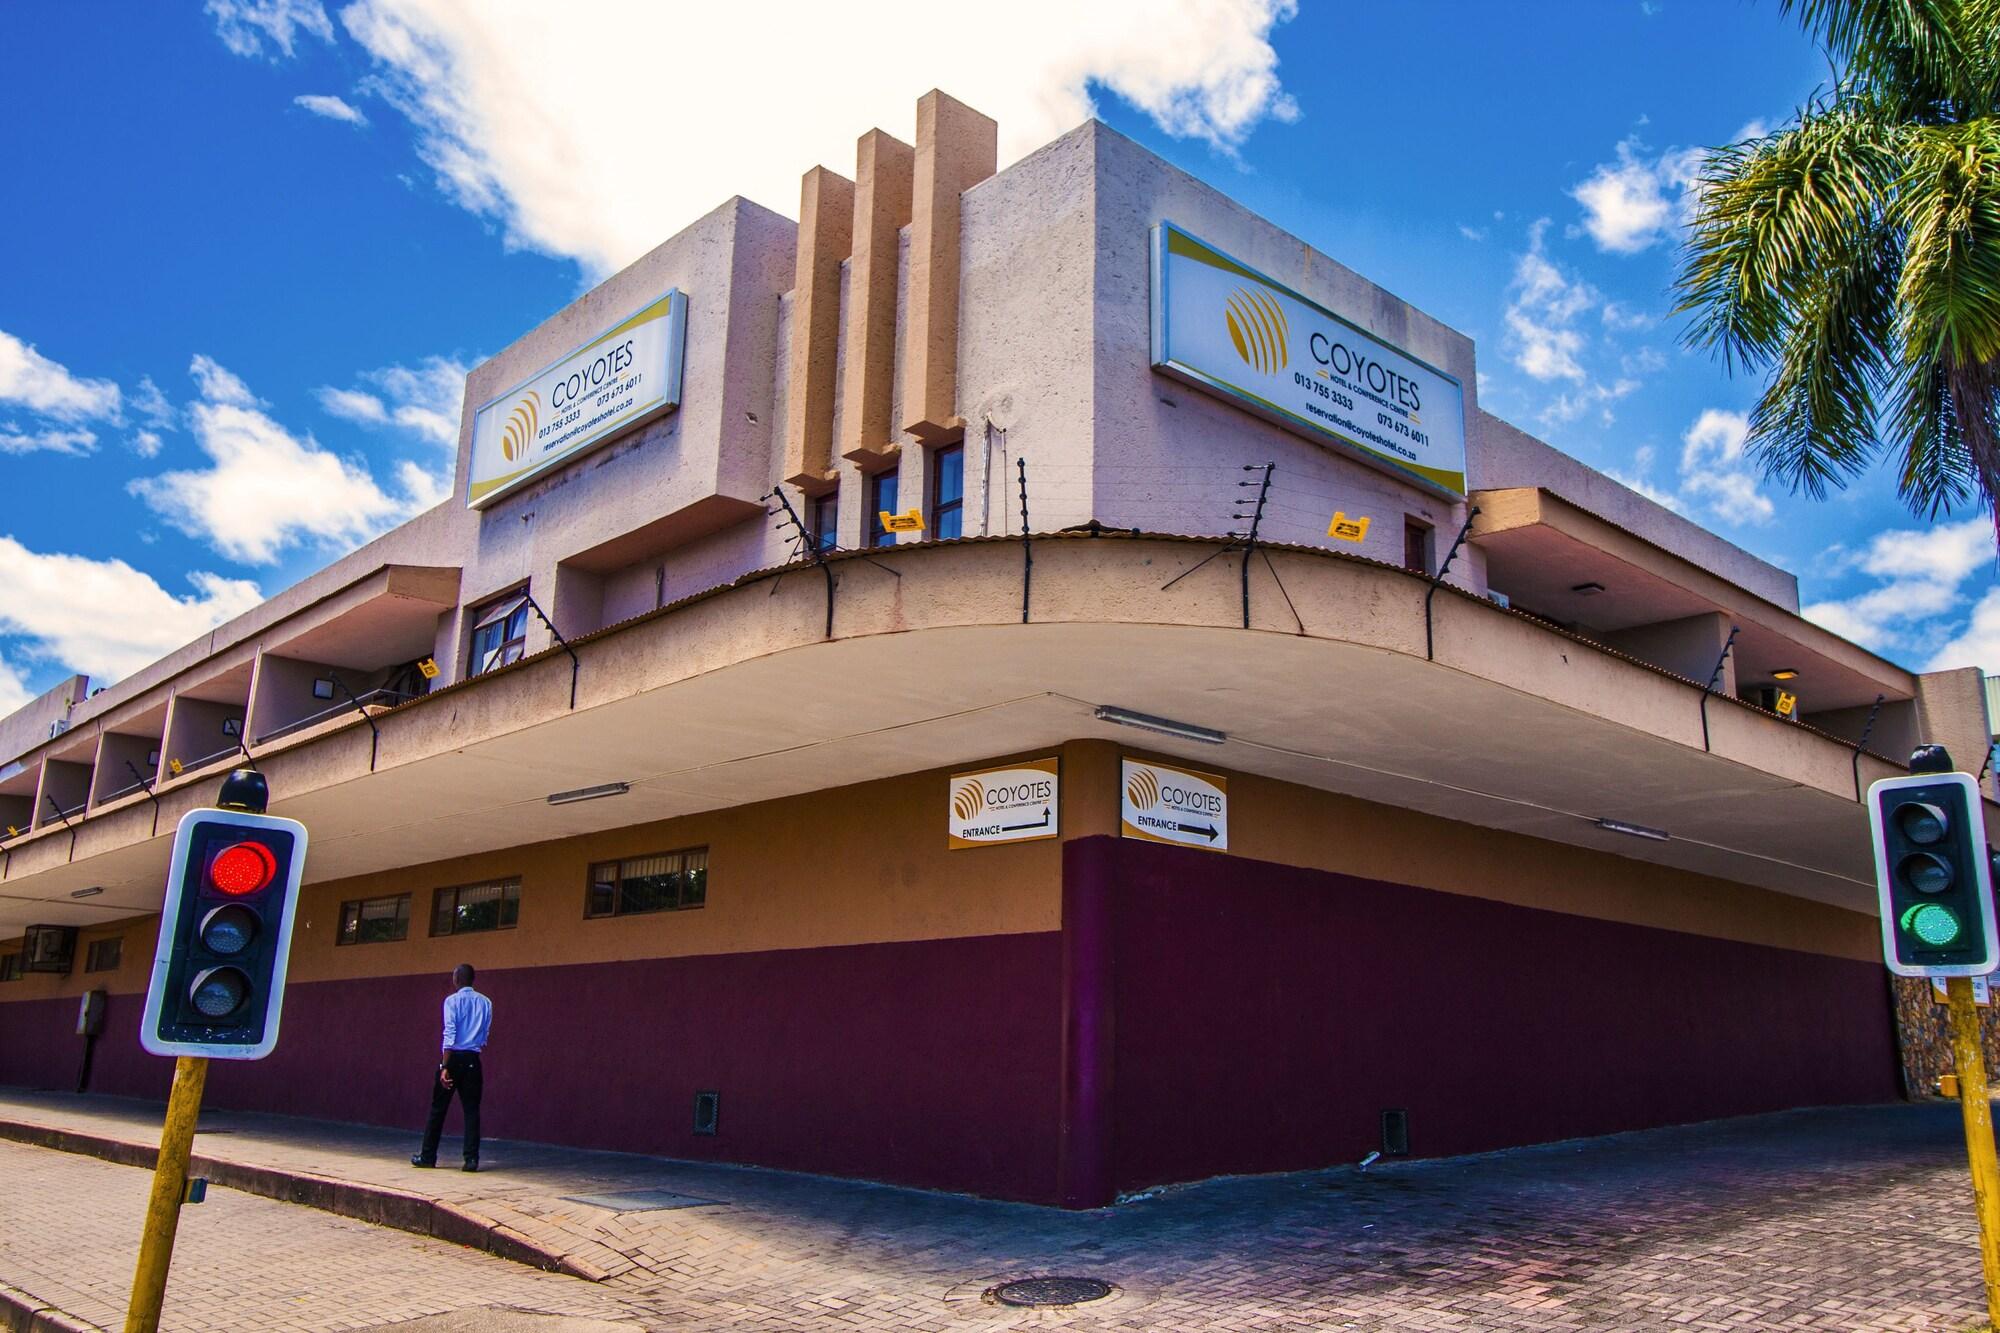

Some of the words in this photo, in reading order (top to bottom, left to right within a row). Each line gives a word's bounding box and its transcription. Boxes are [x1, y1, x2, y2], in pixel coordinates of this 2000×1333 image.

[552, 340, 633, 409] COYOTES
[1310, 332, 1420, 411] COYOTES
[597, 393, 610, 407] 073
[611, 384, 624, 399] 673
[625, 373, 642, 391] 6011
[1294, 372, 1311, 390] 013
[1313, 382, 1330, 399] 755
[1331, 391, 1354, 411] 3333
[1330, 374, 1347, 390] HOTEL
[1353, 385, 1389, 409] CONFERENCE
[1390, 403, 1409, 419] CENTRE
[538, 425, 551, 439] 013
[552, 418, 563, 433] 755
[564, 409, 581, 424] 3333
[1305, 402, 1417, 461] reservation@coyoteshotel.co.za
[1377, 413, 1393, 429] 073
[1395, 421, 1409, 437] 673
[1411, 429, 1429, 447] 6011
[986, 781, 1051, 805] COYOTES
[1161, 786, 1222, 812] COYOTES
[963, 825, 1000, 838] ENTRANCE
[1138, 815, 1177, 831] ENTRANCE
